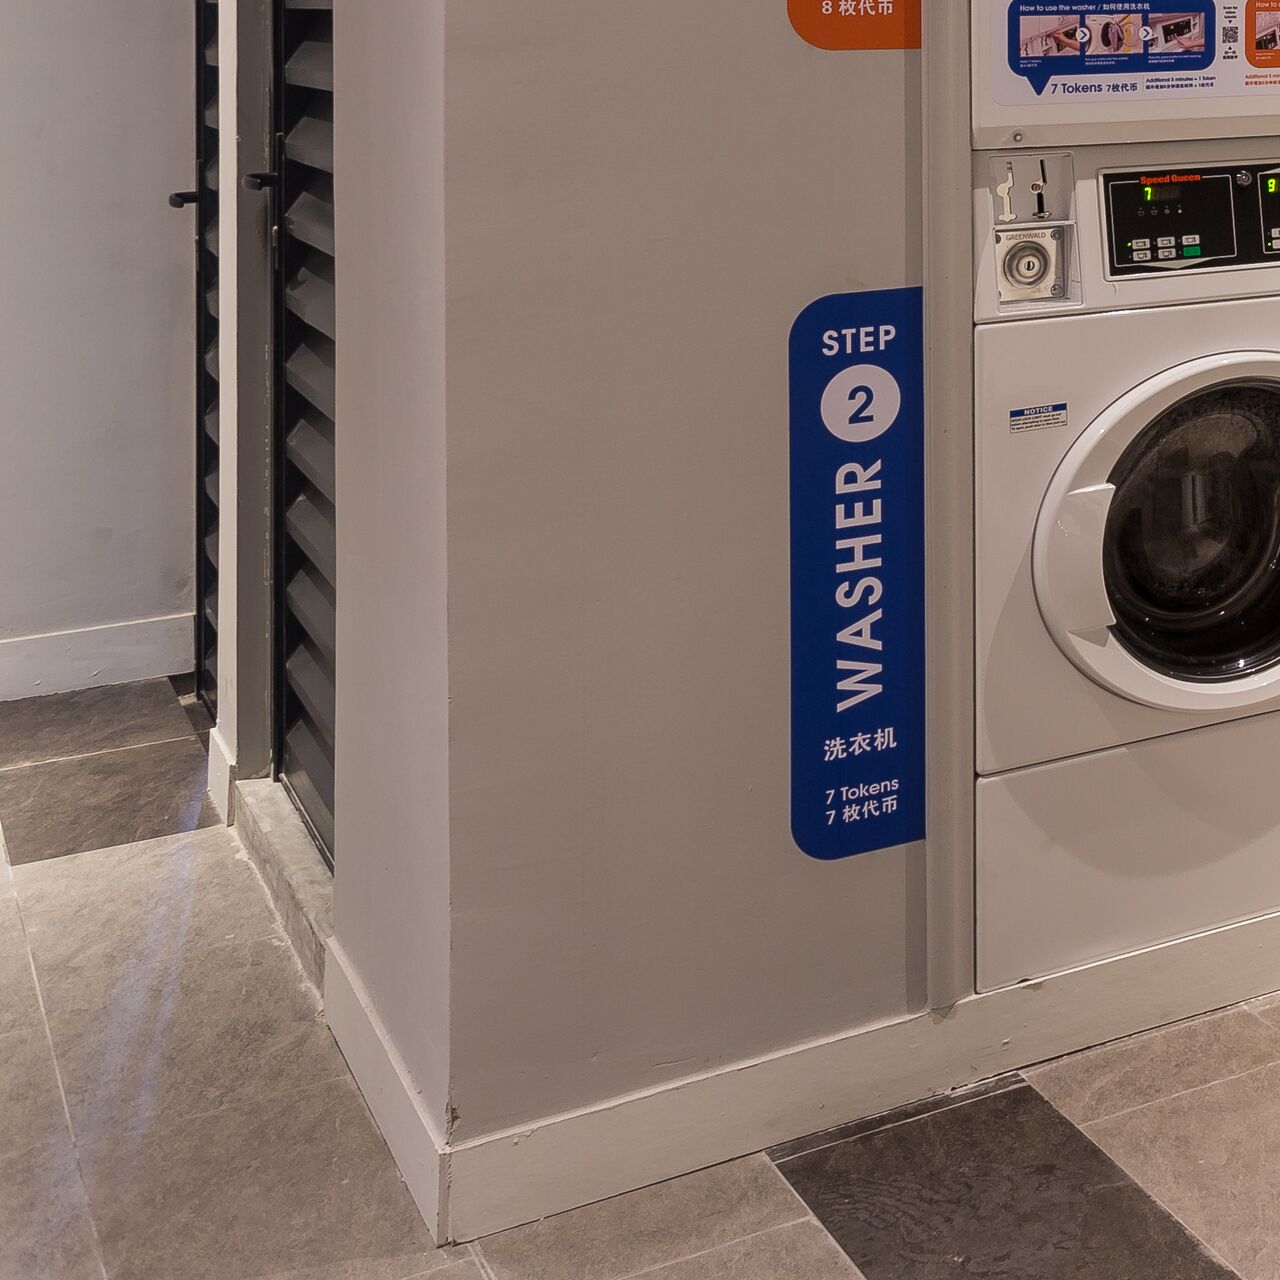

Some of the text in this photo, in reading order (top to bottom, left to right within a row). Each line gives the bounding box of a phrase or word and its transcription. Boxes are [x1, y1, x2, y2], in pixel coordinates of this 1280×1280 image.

[1020, 4, 1034, 12] How
[1072, 3, 1096, 11] washer
[1051, 83, 1058, 94] 7
[1061, 82, 1103, 94] Tokens
[1106, 82, 1138, 93] 7枚代币
[1140, 174, 1200, 185] Speed Queen
[1006, 232, 1047, 240] GREENWALD
[822, 324, 897, 356] STEP
[847, 384, 875, 425] 2
[1024, 406, 1053, 415] NOTICE
[836, 458, 883, 713] WASHER
[824, 727, 897, 762] 洗衣机
[826, 776, 899, 805] 7 Tokens
